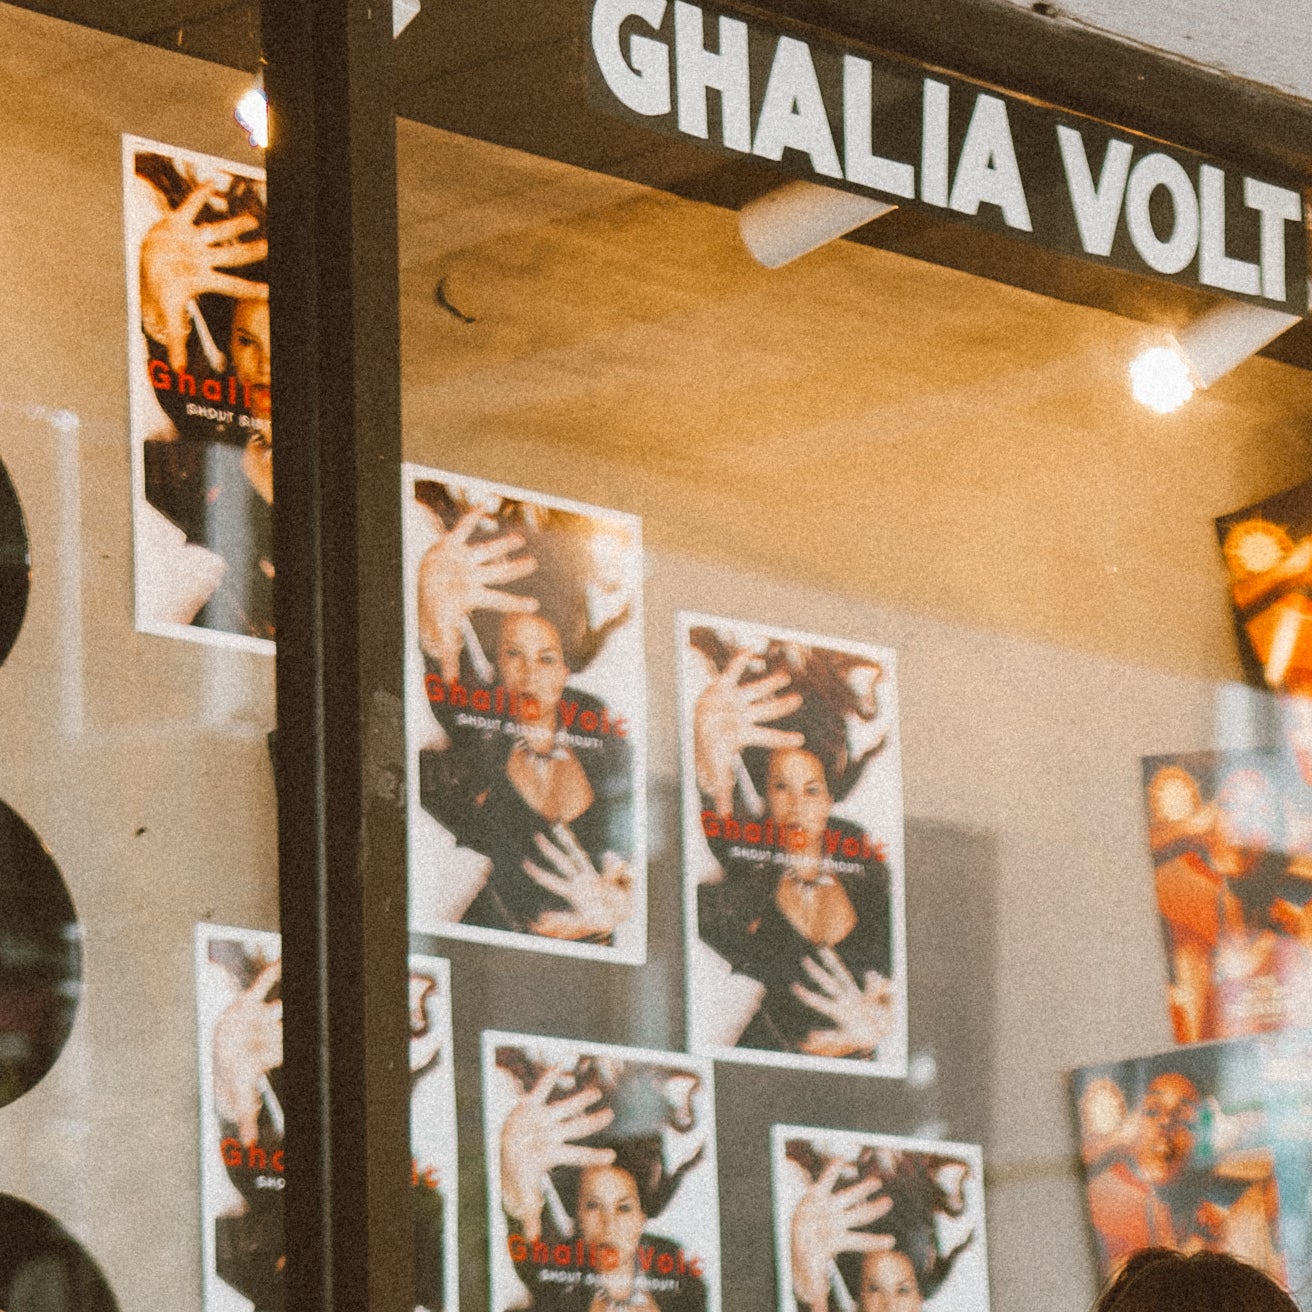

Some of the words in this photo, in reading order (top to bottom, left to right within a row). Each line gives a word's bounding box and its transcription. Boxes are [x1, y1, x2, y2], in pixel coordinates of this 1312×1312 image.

[589, 0, 1034, 233] GHALIA
[1055, 124, 1305, 303] VOLT
[186, 403, 234, 424] SHOUT
[424, 673, 541, 721] Ghalia
[701, 809, 807, 850] Ghalia
[508, 1234, 620, 1272] Ghalia
